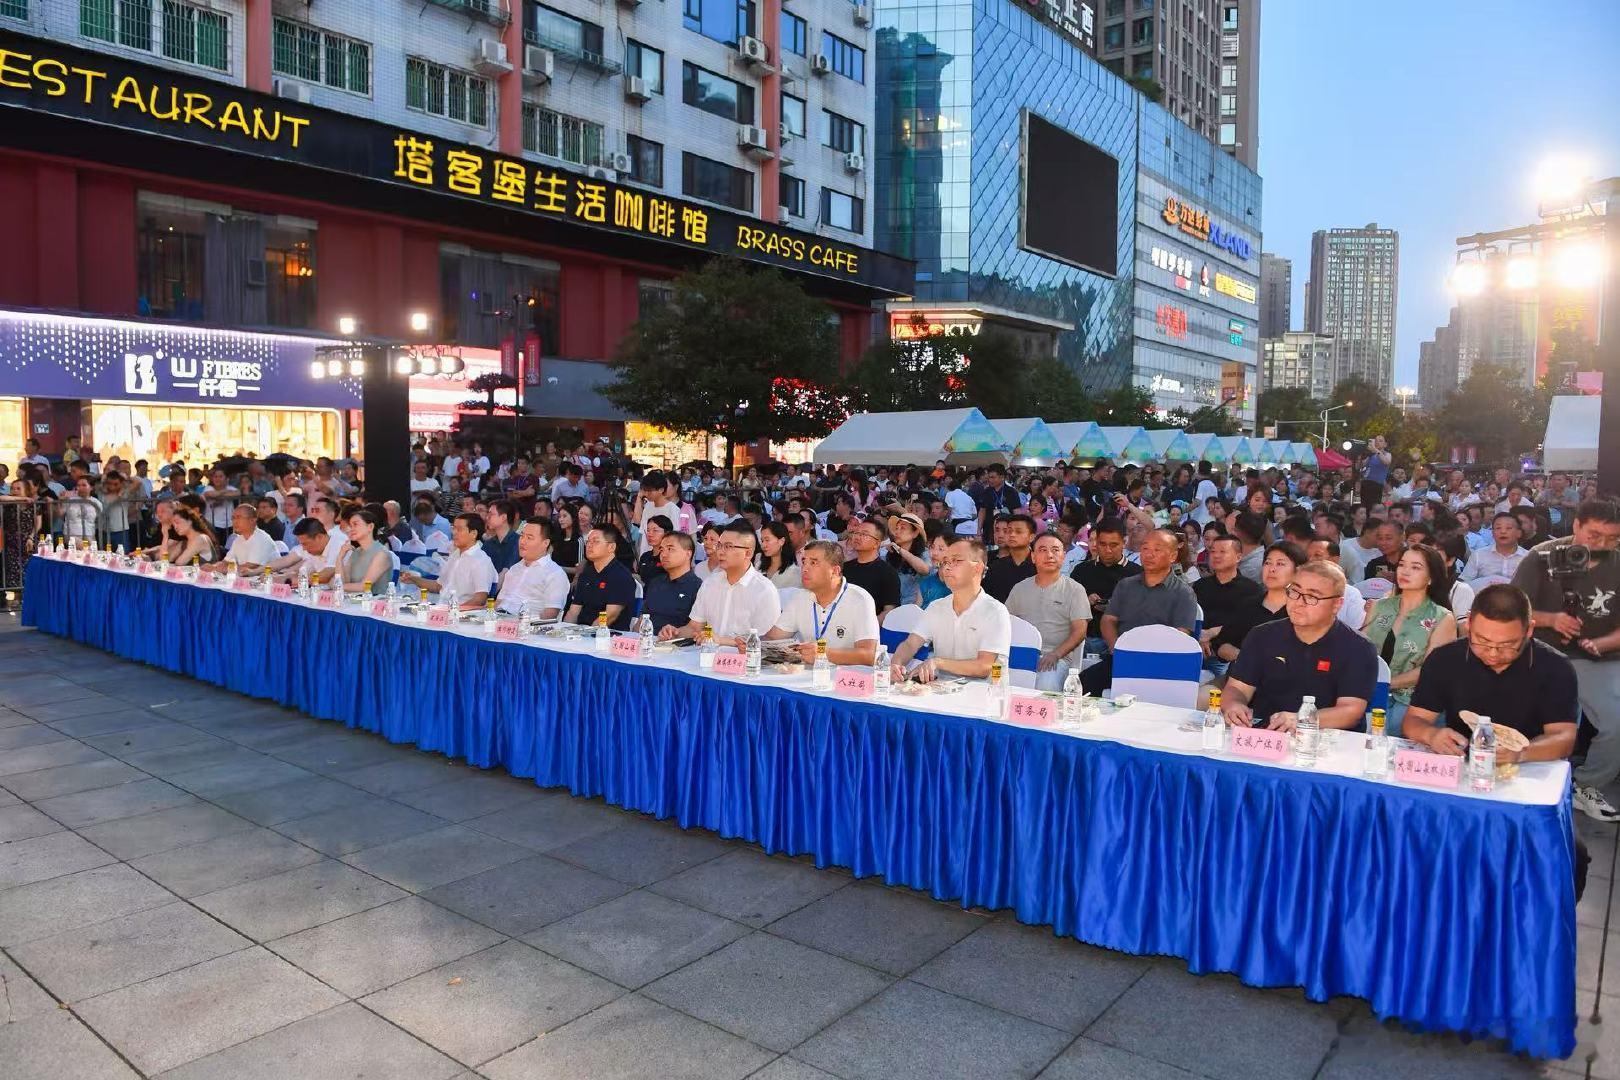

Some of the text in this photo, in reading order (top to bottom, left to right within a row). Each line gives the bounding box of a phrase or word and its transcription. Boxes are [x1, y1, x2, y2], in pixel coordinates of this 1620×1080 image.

[393, 134, 708, 243] 塔客堡生活咖啡馆
[737, 225, 858, 273] BRASS CAFE
[1209, 221, 1250, 261] XLAND
[944, 323, 981, 337] KTV
[1014, 702, 1048, 719] 商务局
